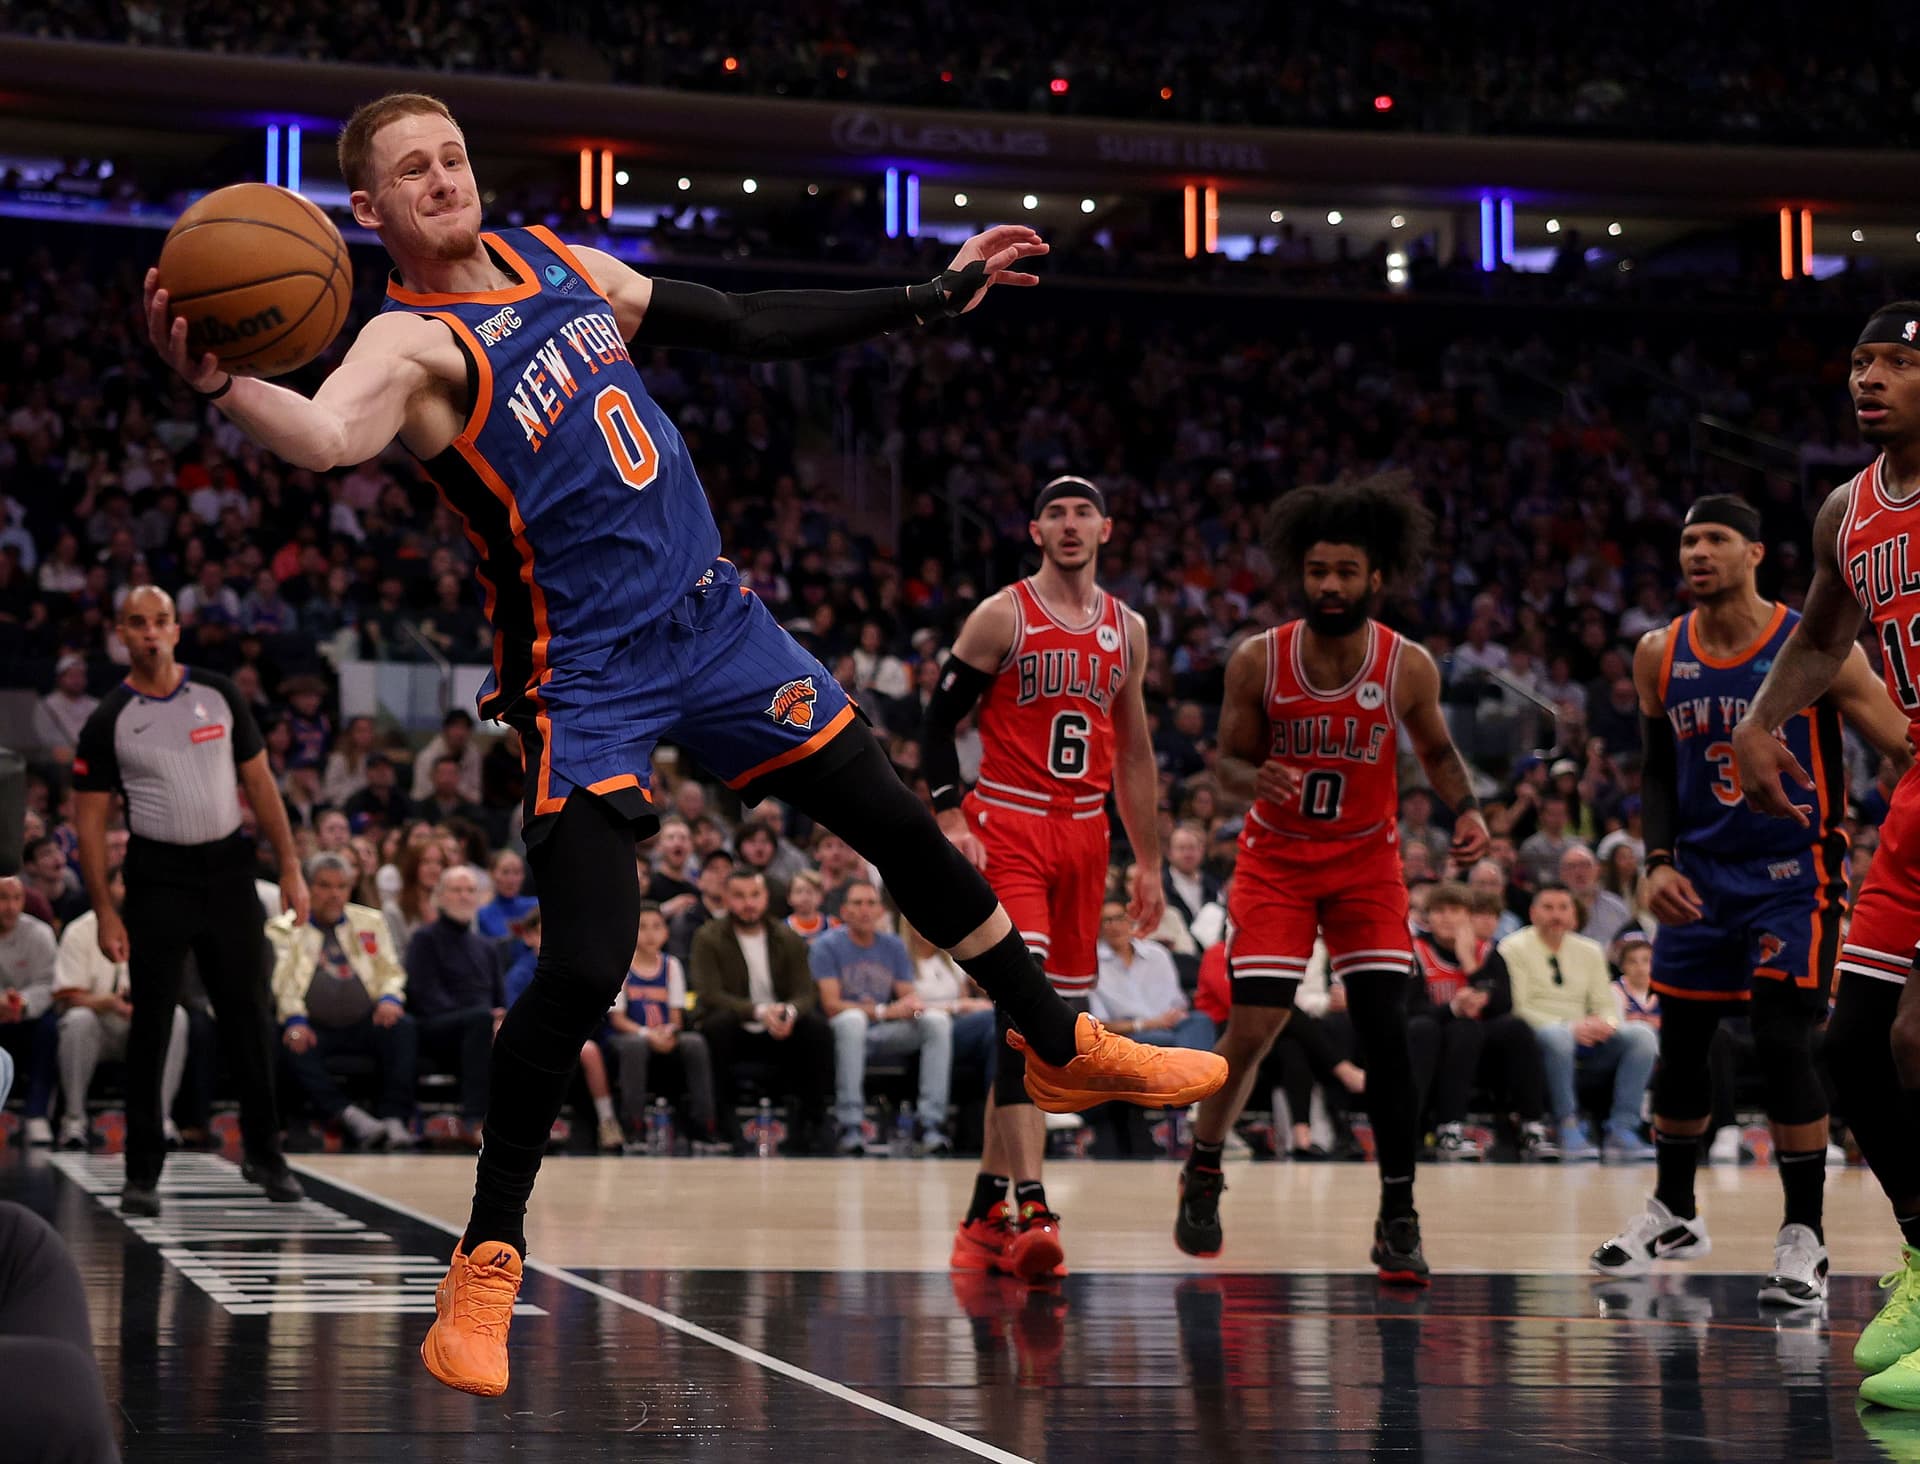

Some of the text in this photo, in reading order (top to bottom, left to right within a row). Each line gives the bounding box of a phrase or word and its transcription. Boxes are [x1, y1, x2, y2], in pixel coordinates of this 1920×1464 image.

[891, 125, 1049, 156] LEXUS
[1183, 139, 1266, 169] LEVEL
[474, 306, 523, 347] NYC
[507, 338, 579, 453] NEW
[593, 384, 660, 490] 0
[774, 682, 816, 721] KNICKS
[1667, 696, 1711, 741] NEW
[1047, 710, 1092, 779] 6
[1270, 715, 1389, 765] BULLS
[1300, 768, 1345, 821] 0
[1705, 741, 1745, 807] 3
